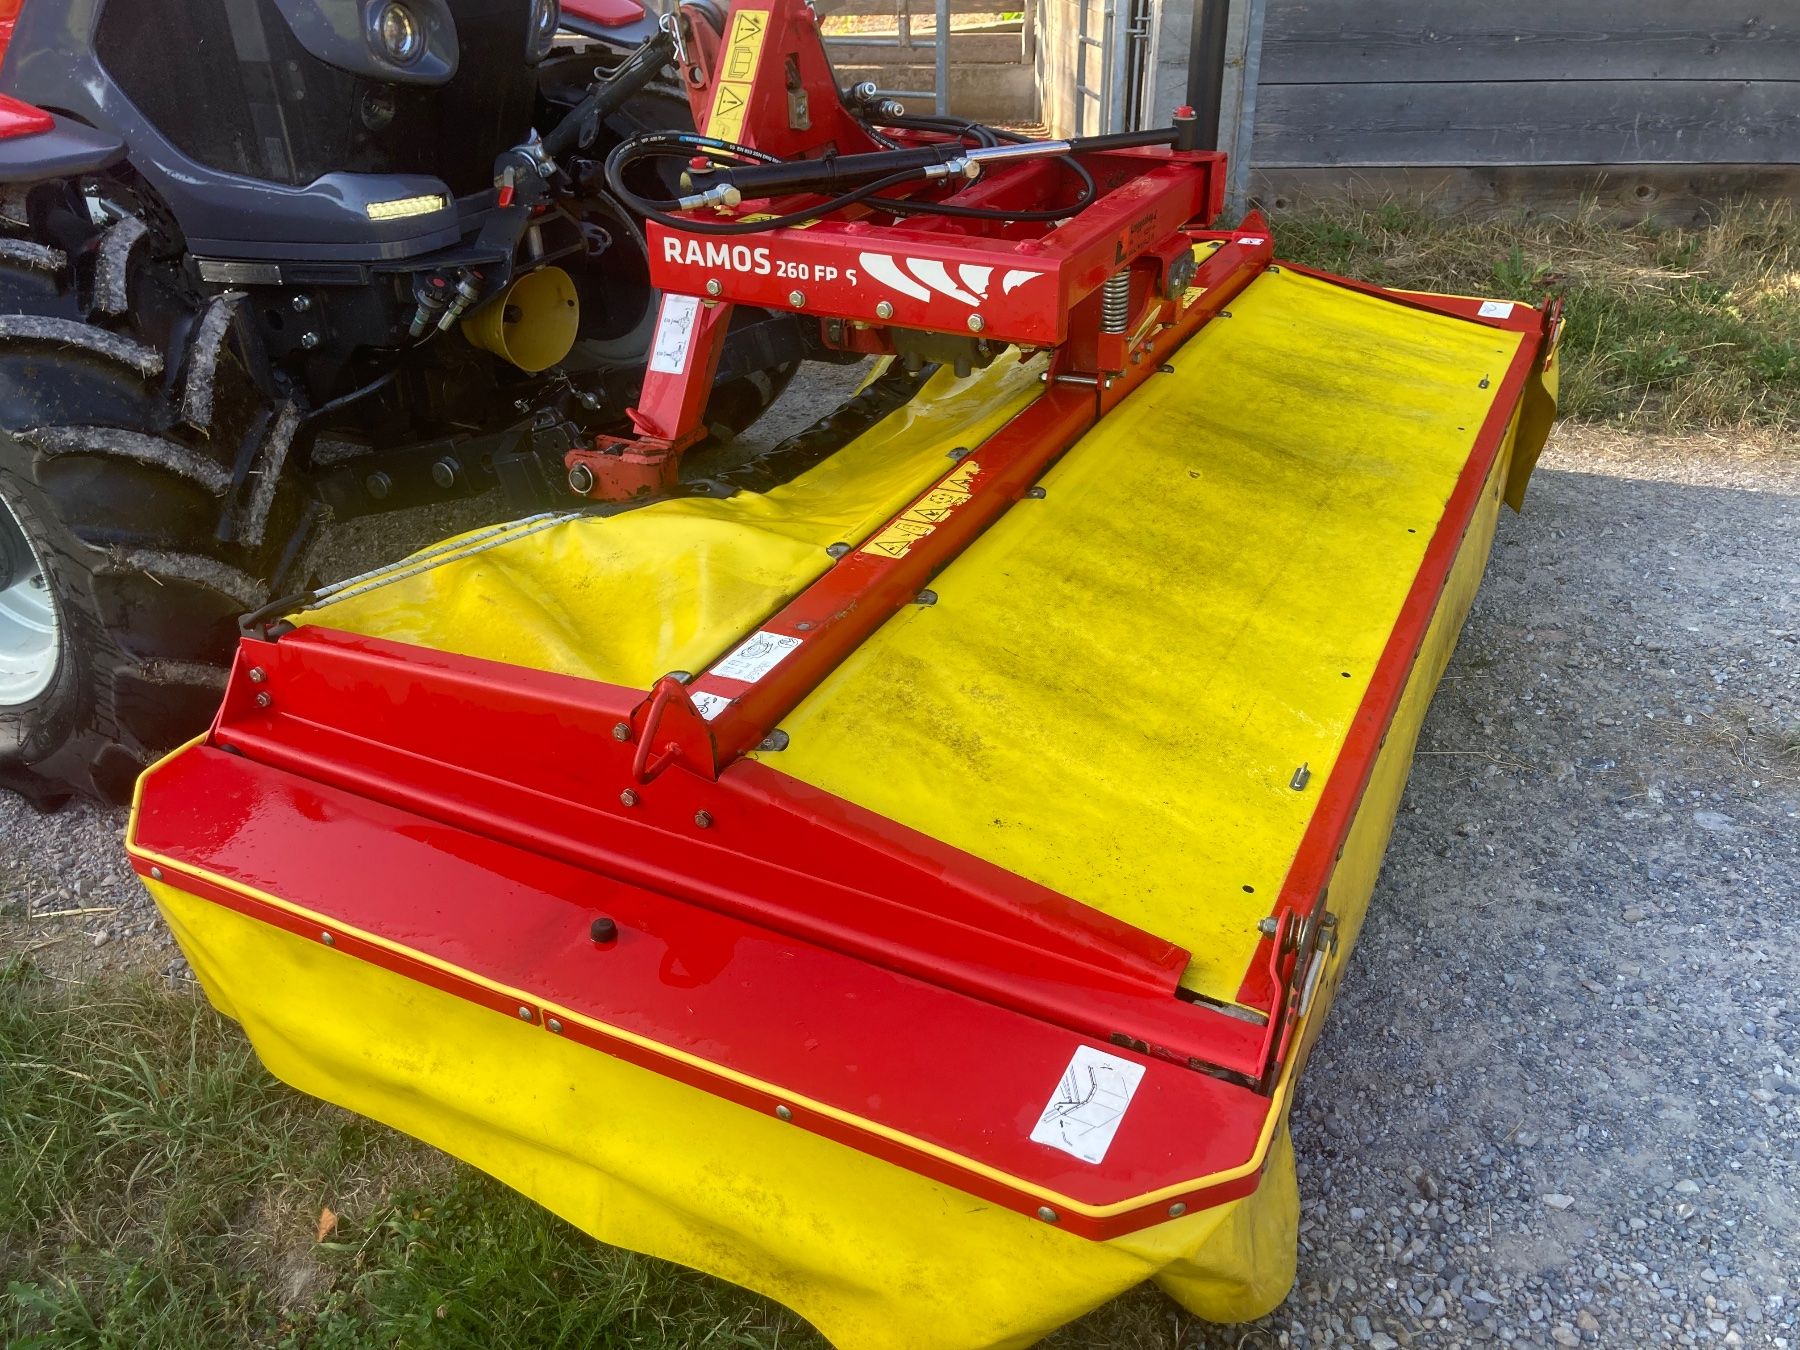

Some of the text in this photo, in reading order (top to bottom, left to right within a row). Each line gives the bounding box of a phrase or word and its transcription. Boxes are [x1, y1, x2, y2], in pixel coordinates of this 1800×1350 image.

[663, 236, 771, 275] RAMOS
[776, 260, 809, 280] 260
[814, 264, 838, 282] FP
